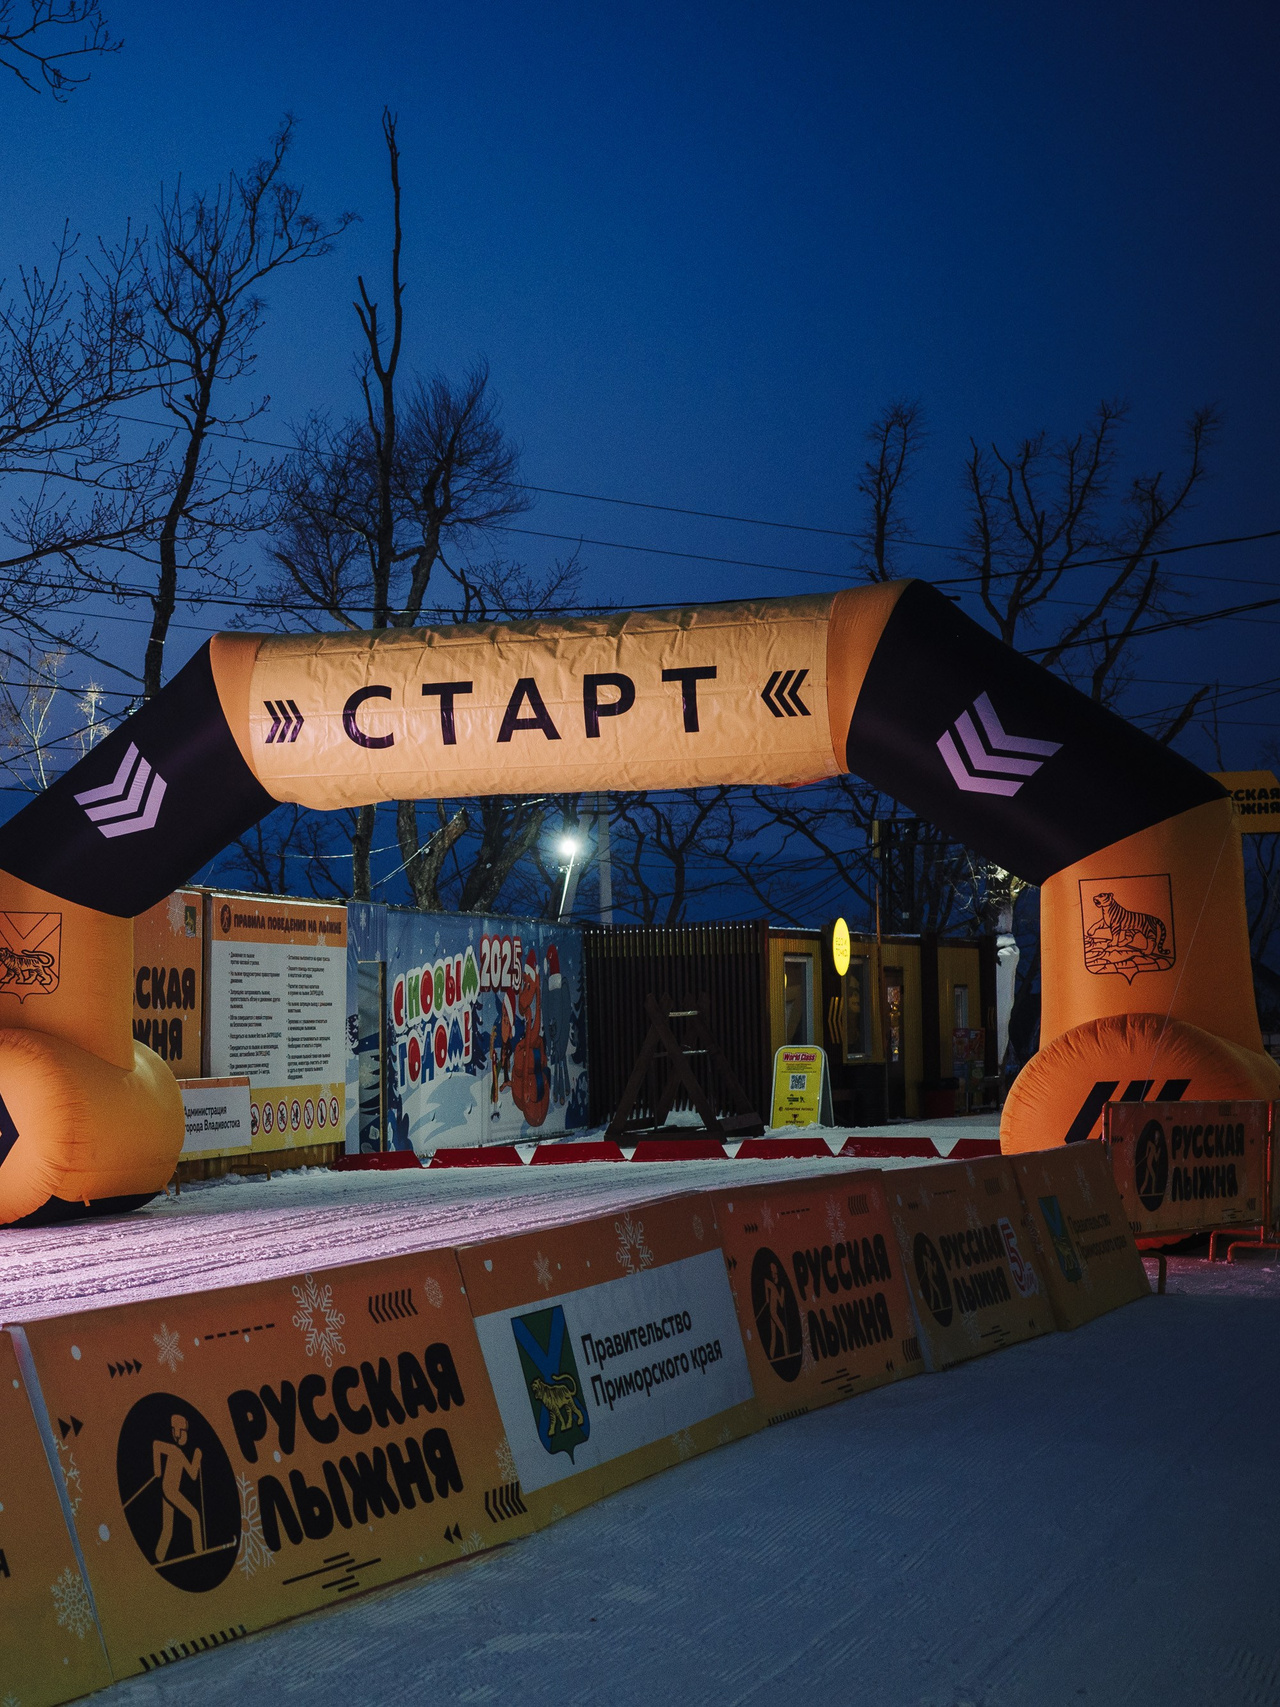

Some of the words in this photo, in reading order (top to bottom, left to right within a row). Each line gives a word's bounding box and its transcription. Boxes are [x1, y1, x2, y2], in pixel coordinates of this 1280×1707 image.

[342, 665, 718, 750] СТАРТ
[1237, 801, 1280, 815] ЖНЯ
[234, 913, 266, 930] ПРАВИЛА
[268, 916, 306, 934] ПОВЕДЕНИЯ
[308, 919, 317, 933] НА
[319, 920, 342, 935] ЛЫЖНЕ
[133, 966, 196, 1010] СКАЯ
[392, 976, 406, 1031] С
[407, 948, 479, 1023] НОВЫМ
[480, 937, 522, 991] 2025
[133, 1017, 183, 1061] ЖНЯ
[397, 1008, 471, 1089] ГОДОМ!
[783, 1052, 801, 1062] World
[801, 1052, 816, 1061] Class
[185, 1122, 203, 1135] орода
[204, 1119, 241, 1132] Владивостока
[1171, 1122, 1245, 1161] РУССКАЯ
[1172, 1163, 1239, 1203] ЛЫЖНЯ
[792, 1233, 892, 1301] РУССКАЯ
[938, 1223, 1006, 1271] РУССКАЯ
[952, 1266, 1012, 1314] ЛЫЖНЯ
[580, 1309, 693, 1370] Правительство
[807, 1292, 893, 1362] ЛЫЖНЯ
[590, 1352, 690, 1411] Приморского
[691, 1338, 724, 1379] края
[227, 1342, 466, 1464] РУССКАЯ
[257, 1426, 464, 1553] ЛЫЖНЯ
